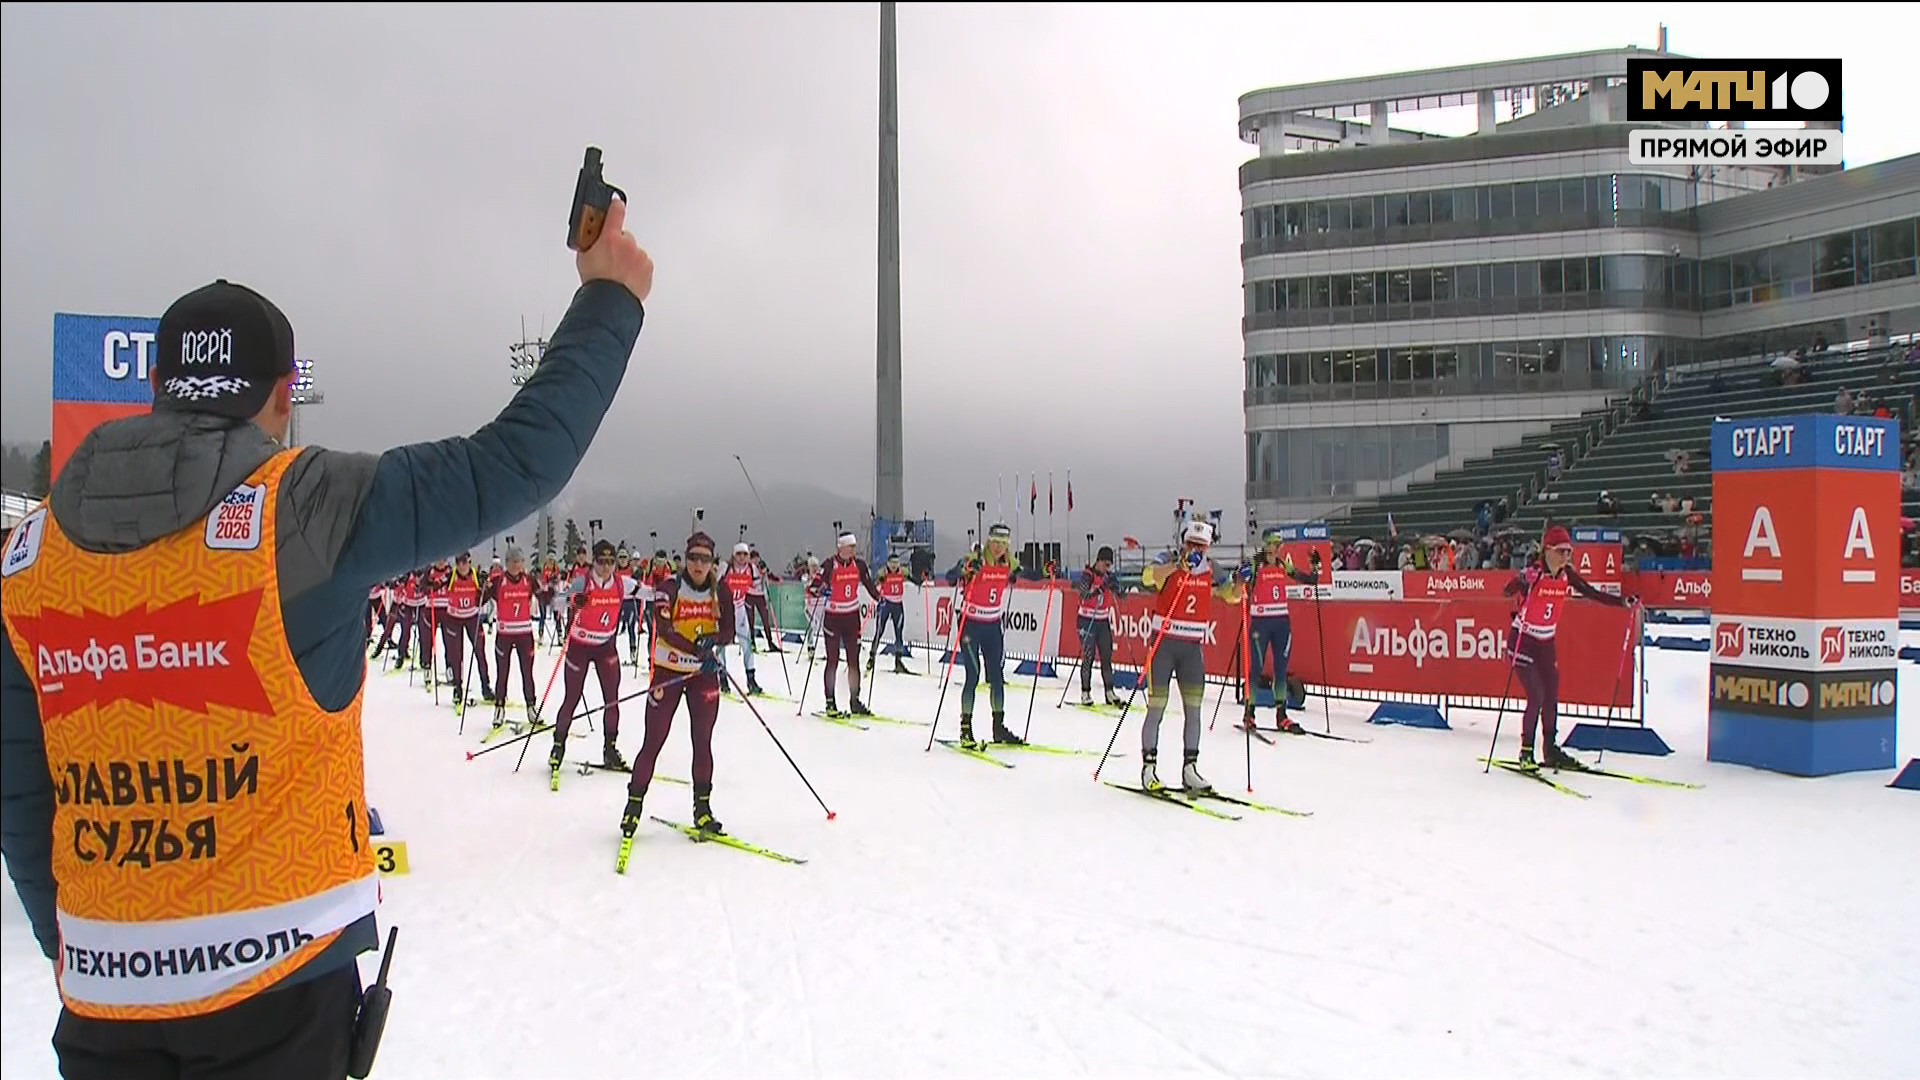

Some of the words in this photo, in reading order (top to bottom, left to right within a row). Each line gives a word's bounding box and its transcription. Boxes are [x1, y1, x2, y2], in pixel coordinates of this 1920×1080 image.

[1732, 425, 1795, 458] СТАРТ
[1835, 425, 1885, 457] СТАРТ
[218, 504, 254, 520] 2025
[215, 521, 251, 539] 2026
[845, 584, 852, 598] 8
[1272, 585, 1280, 600] 6
[1334, 579, 1390, 590] ТЕХНОНИКОЛЬ
[1427, 576, 1458, 592] Альфа
[1459, 576, 1485, 590] Банк
[1674, 577, 1712, 598] Альф
[1901, 576, 1920, 594] Ба
[459, 597, 471, 608] 10
[989, 587, 997, 604] 5
[1185, 594, 1197, 614] 2
[513, 603, 520, 618] 7
[600, 611, 609, 627] 4
[1544, 603, 1554, 620] 3
[1108, 606, 1152, 648] Альф
[1747, 627, 1796, 642] ТЕХНО
[1350, 616, 1450, 668] Альфа
[1455, 618, 1508, 659] Бан
[1847, 630, 1886, 643] ТЕХНО
[38, 638, 128, 680] Альфа
[134, 634, 230, 669] Банк
[1749, 643, 1810, 659] НИКОЛЬ
[1849, 645, 1895, 659] НИКОЛЬ
[56, 742, 259, 806] ЛАВНЫЙ
[73, 815, 217, 869] СУДЬЯ
[377, 846, 396, 873] 3
[65, 927, 315, 978] ТЕХНОНИКОЛЬ
